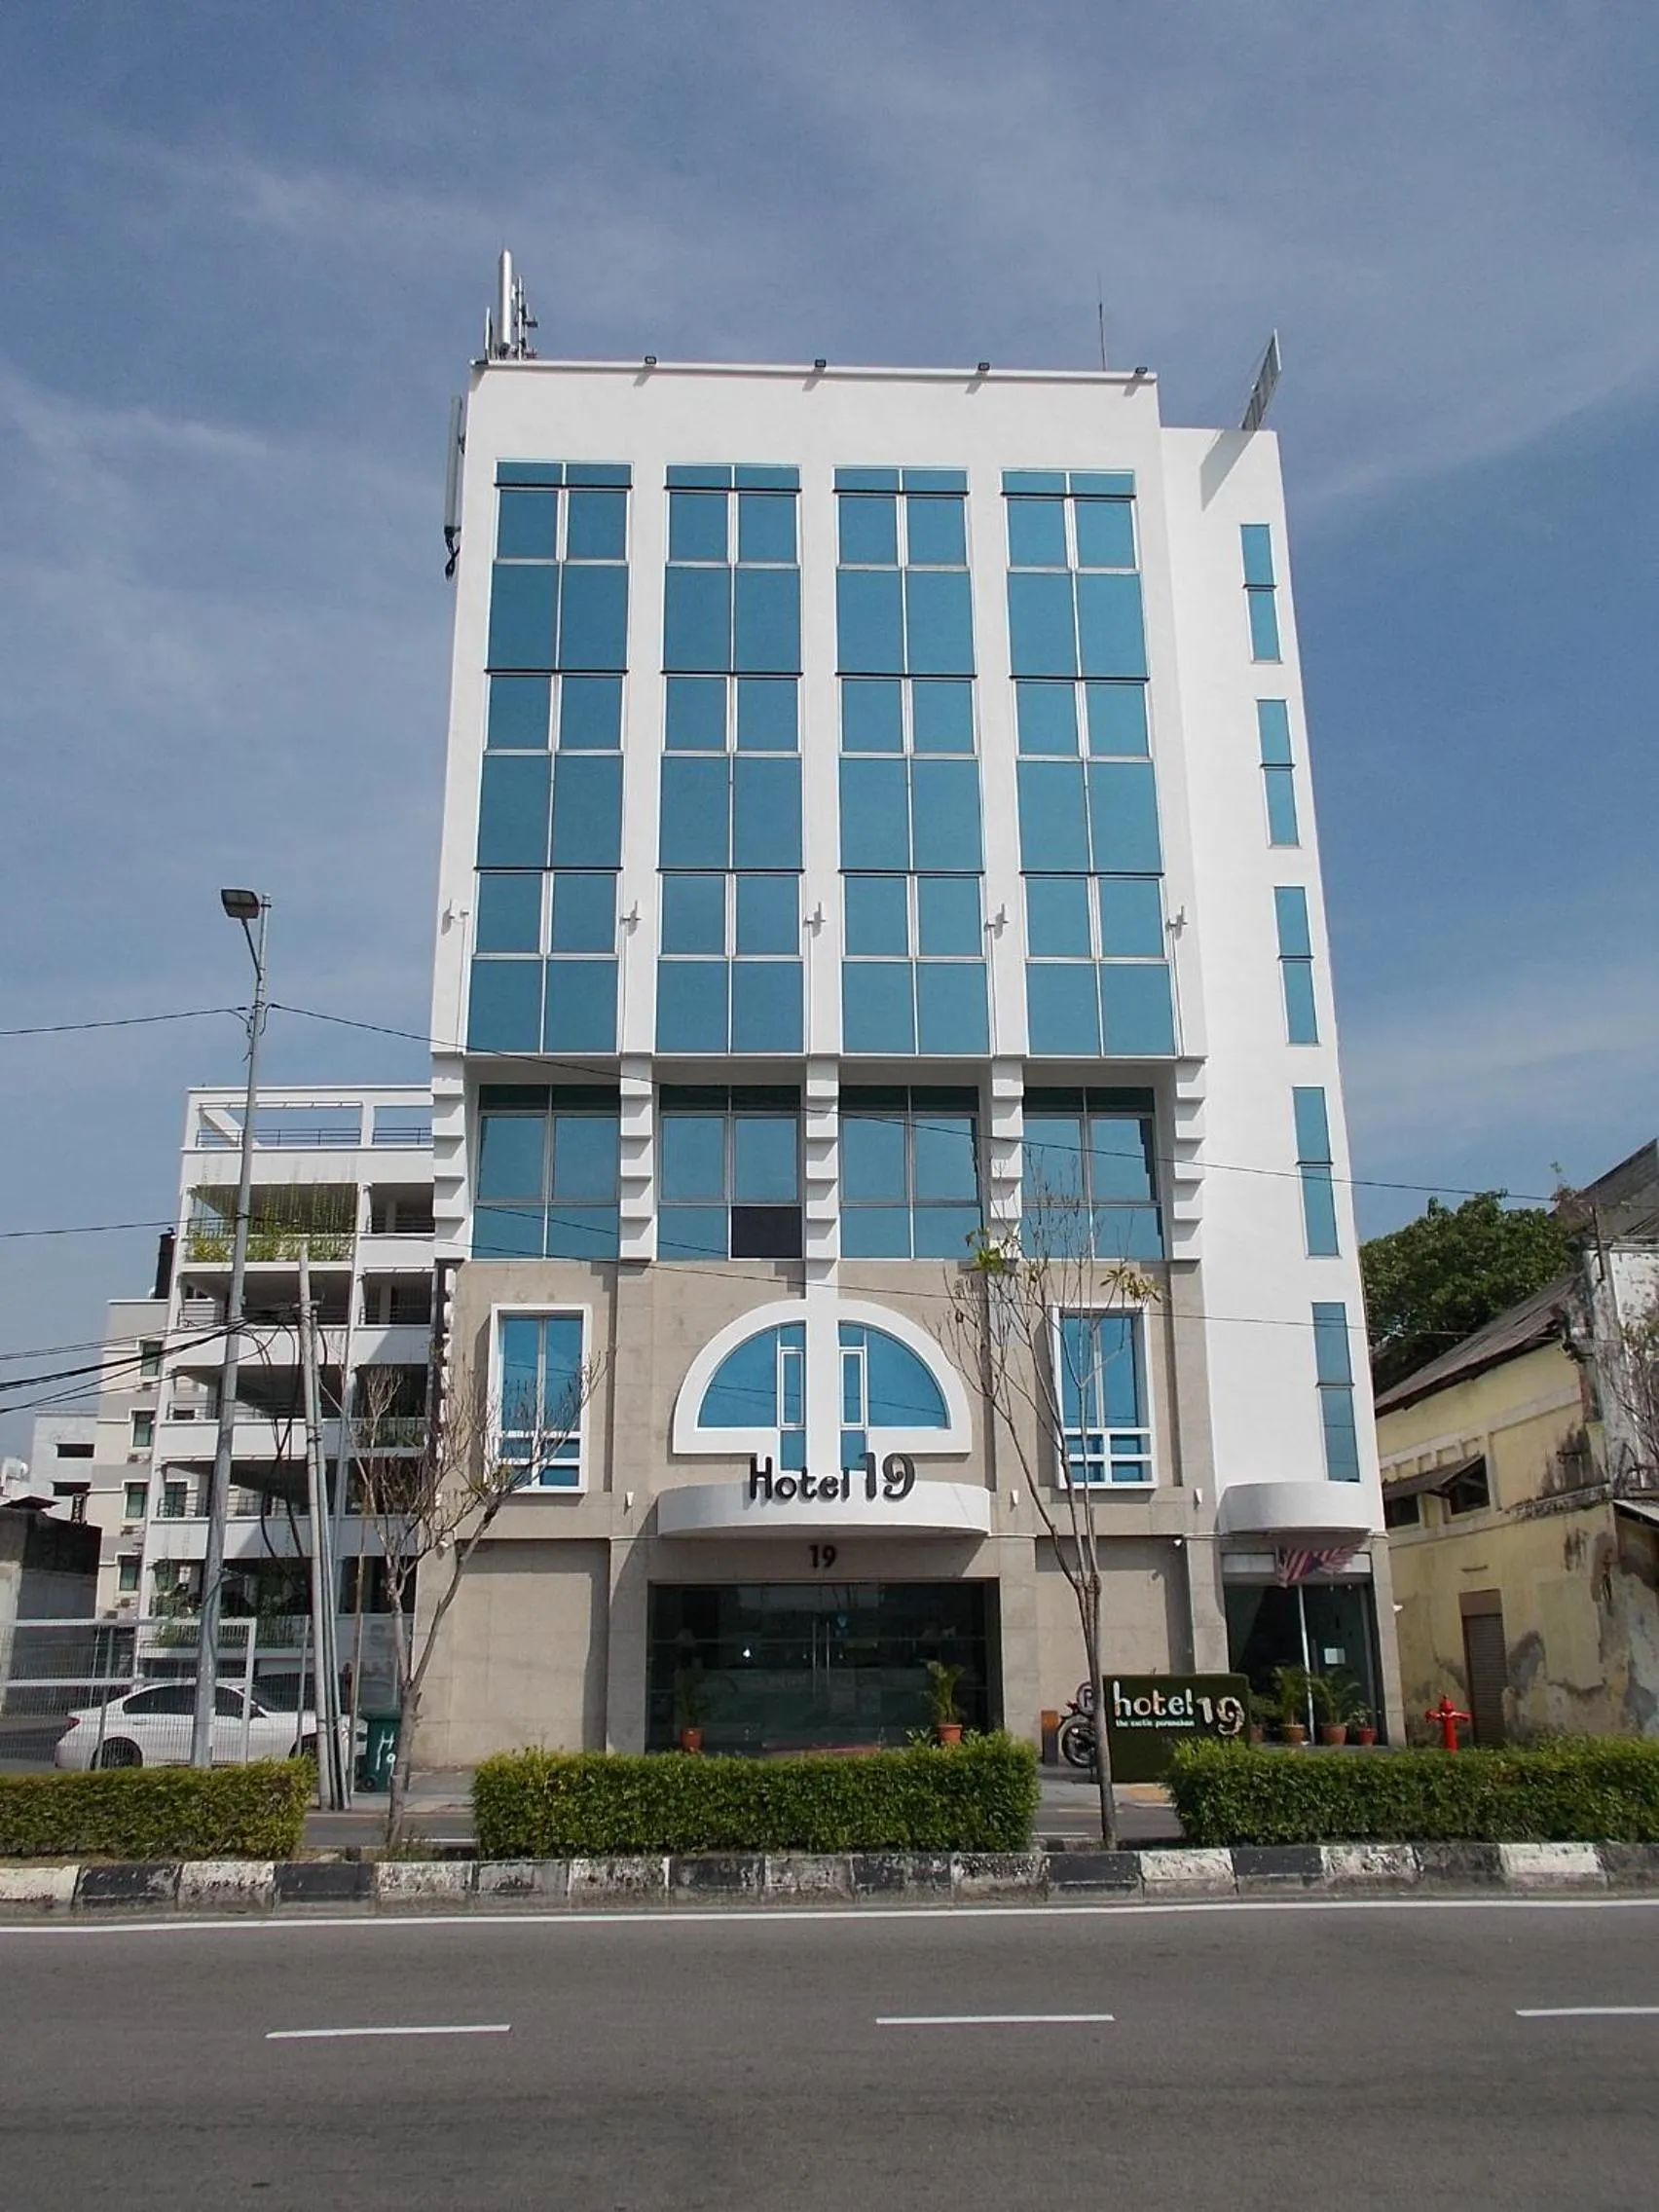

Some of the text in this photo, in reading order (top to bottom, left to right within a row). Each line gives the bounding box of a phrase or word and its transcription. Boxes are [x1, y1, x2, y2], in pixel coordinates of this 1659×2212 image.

[750, 1452, 915, 1500] Hotel 19
[808, 1544, 837, 1568] 19
[1113, 1680, 1245, 1735] hotel 19
